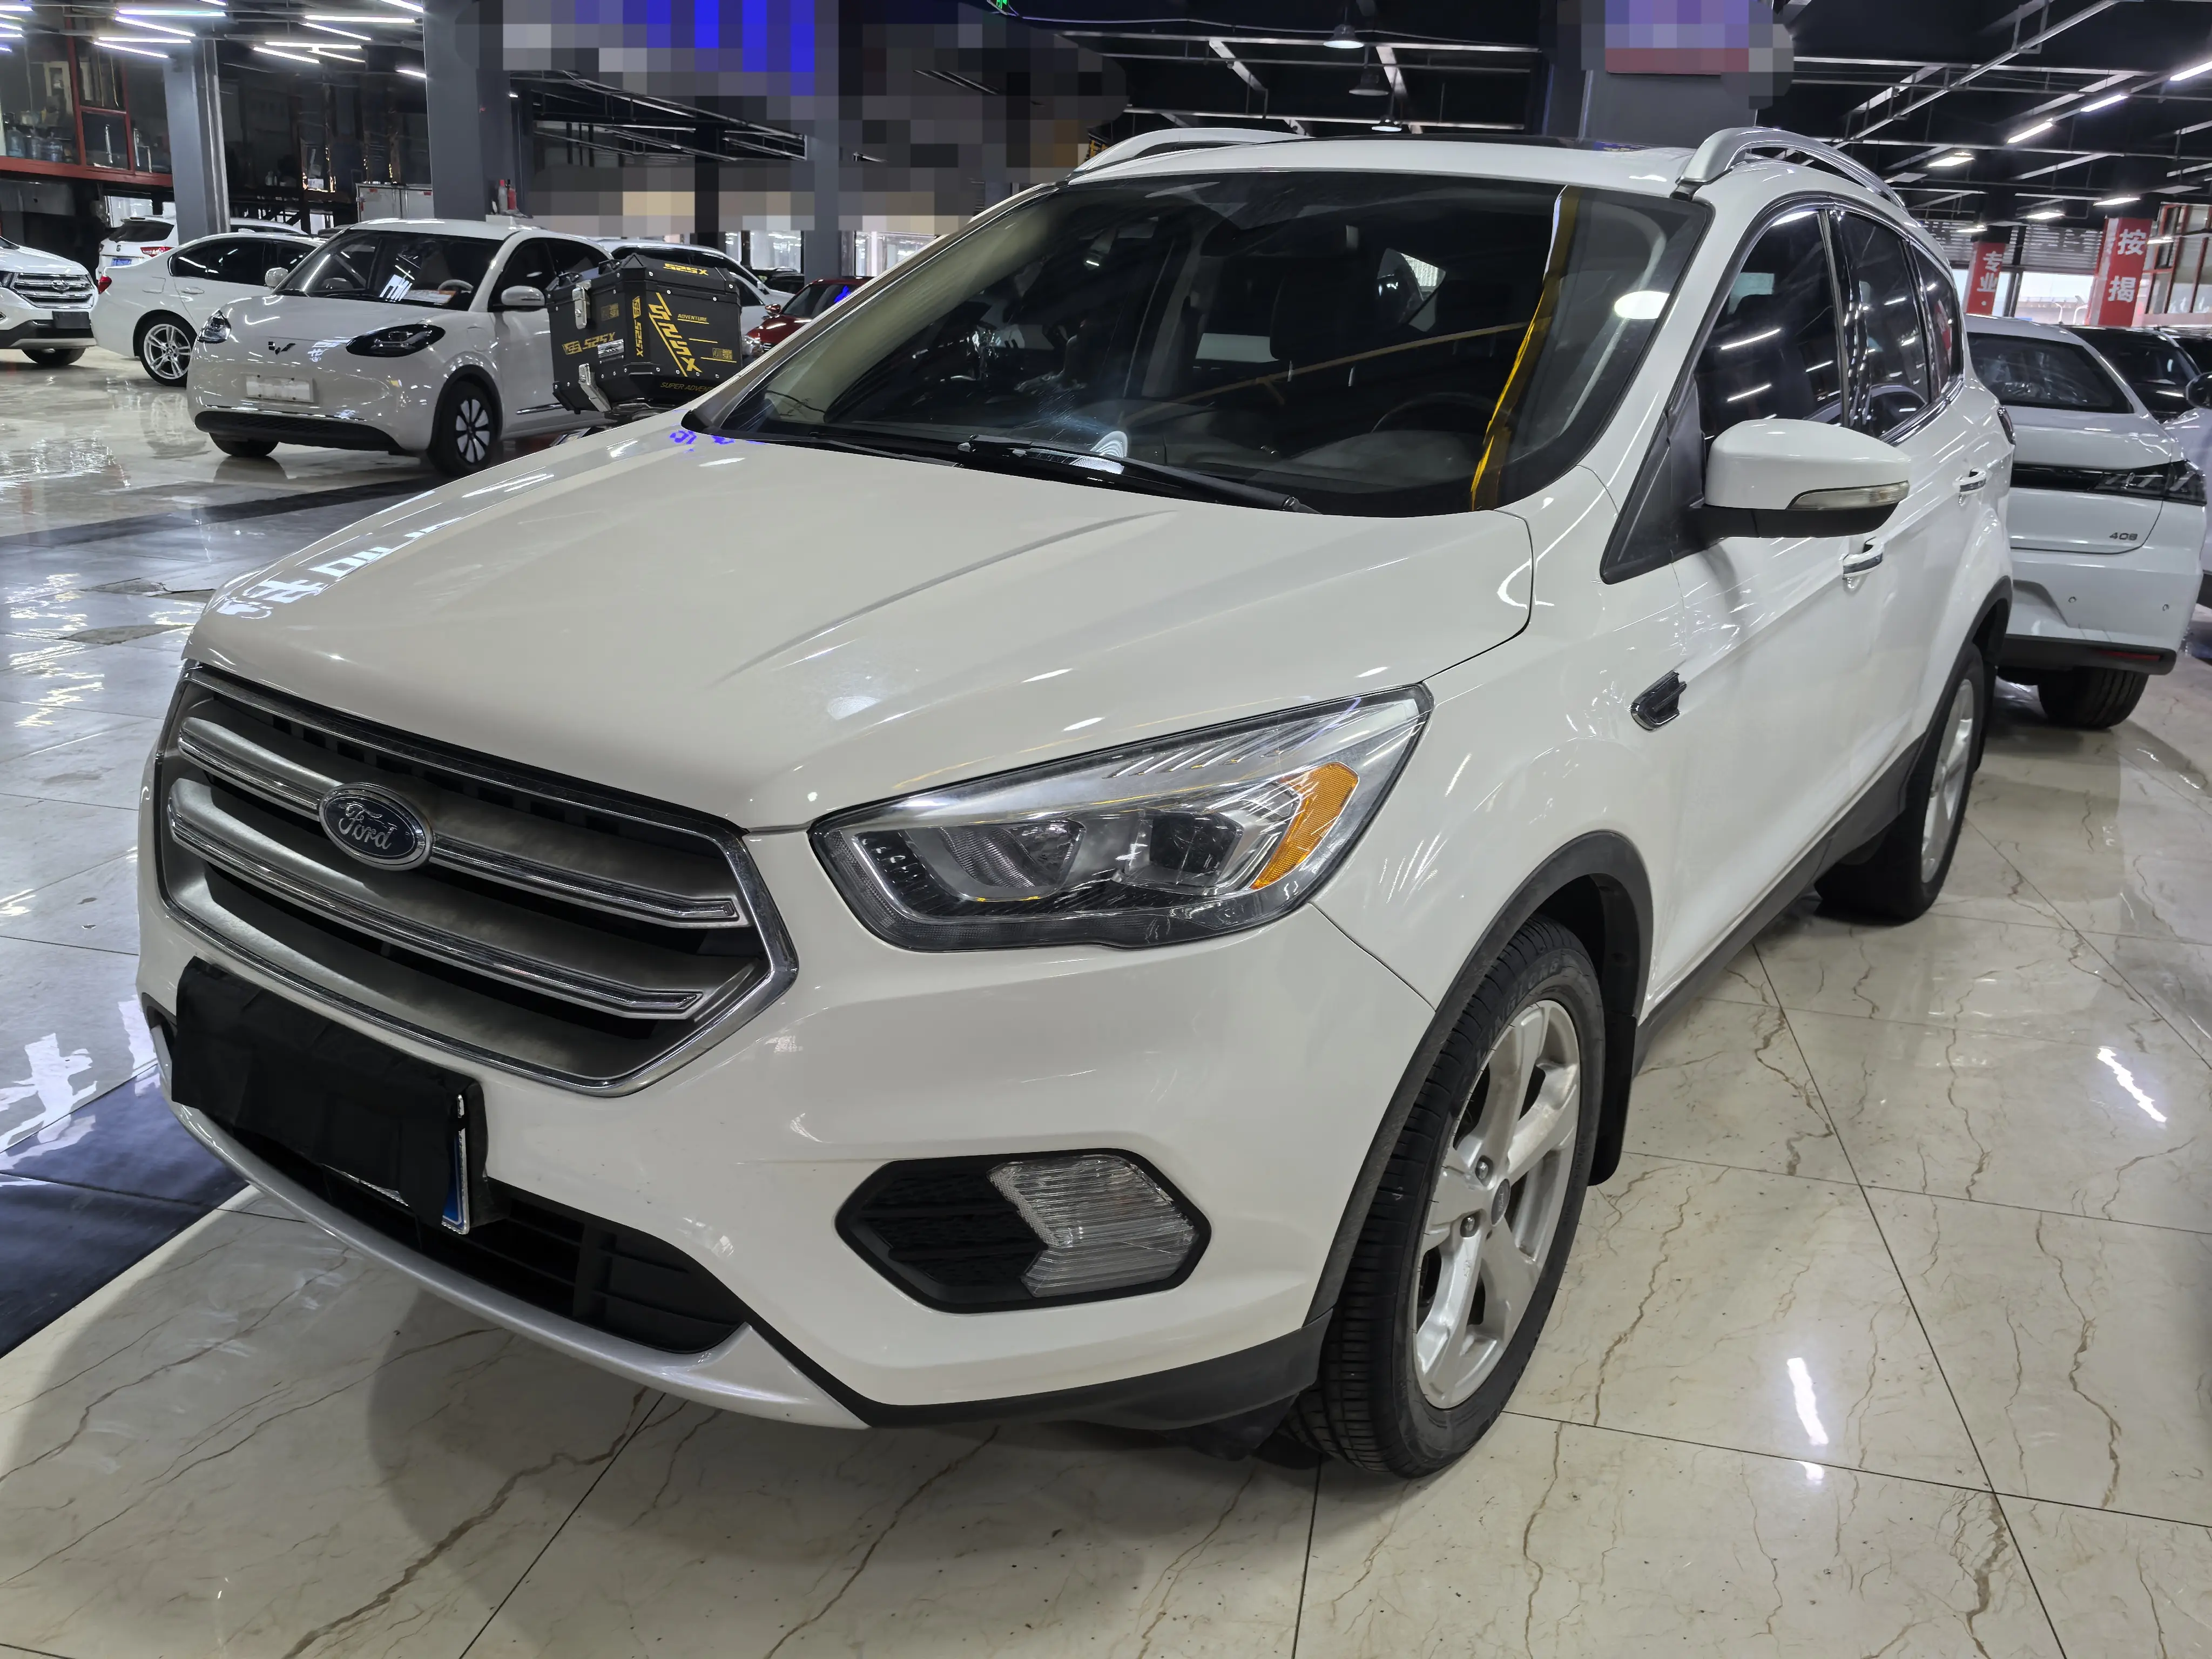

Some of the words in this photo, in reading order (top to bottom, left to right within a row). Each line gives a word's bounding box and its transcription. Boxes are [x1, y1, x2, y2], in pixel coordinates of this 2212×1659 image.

[2108, 228, 2147, 302] 按揭
[649, 304, 702, 373] 525X
[678, 314, 707, 322] ADVENTURE
[338, 801, 397, 849] Ford
